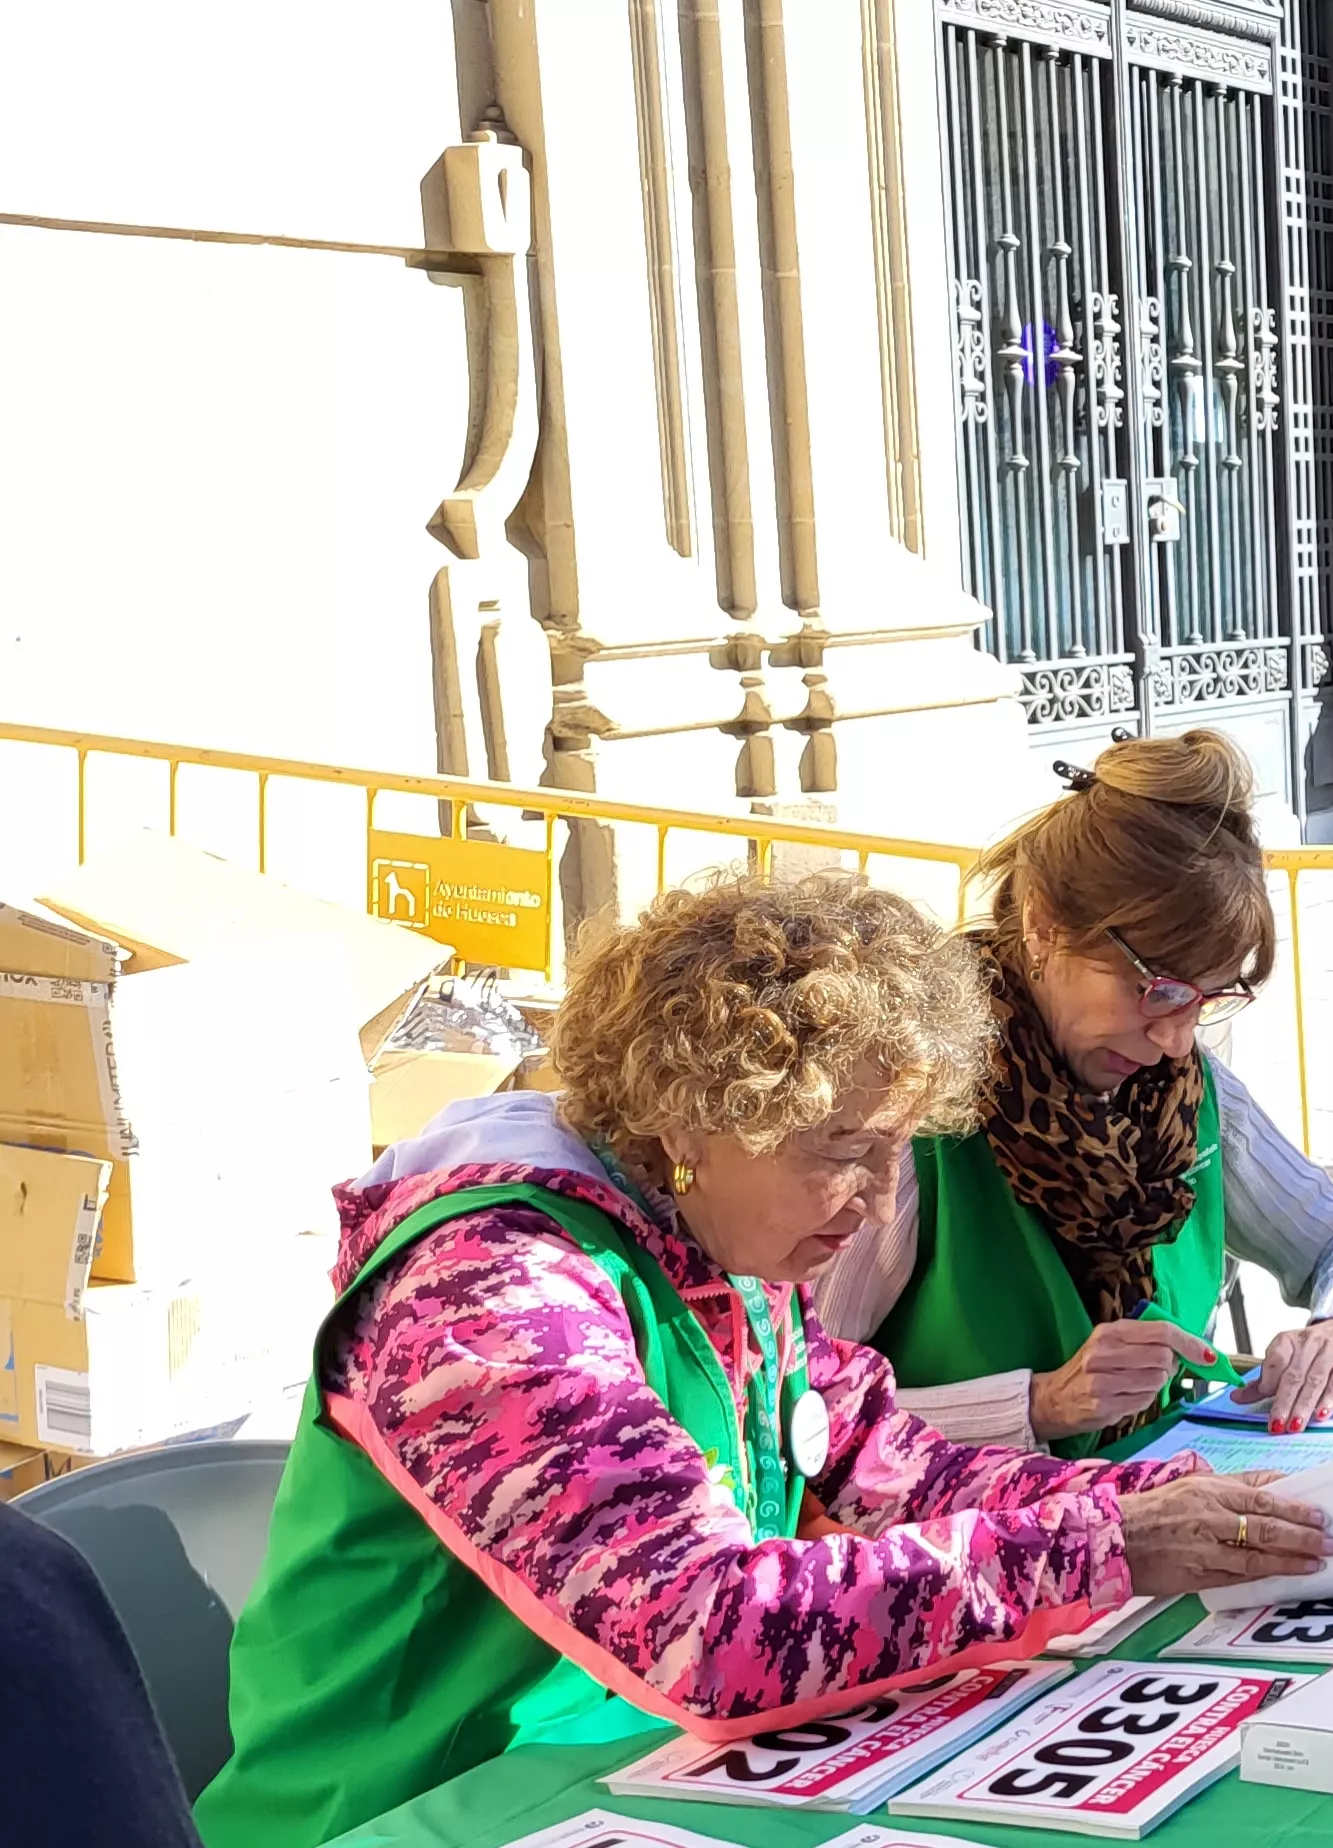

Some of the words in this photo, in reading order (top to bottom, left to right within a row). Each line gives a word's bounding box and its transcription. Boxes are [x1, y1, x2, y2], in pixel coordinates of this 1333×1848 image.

[433, 878, 542, 909] Ayuntamiento
[433, 900, 453, 919] de
[455, 903, 517, 928] Huesca
[903, 1675, 995, 1724] CONTRA
[1181, 1684, 1260, 1735] CONTRA
[875, 1725, 904, 1740] EL
[882, 1715, 950, 1751] HUESCA
[988, 1677, 1219, 1798] 3305
[1160, 1736, 1195, 1751] EL
[1172, 1726, 1232, 1763] HUESCA
[784, 1740, 882, 1789] CÁNCER
[1088, 1752, 1172, 1805] CÁNCER
